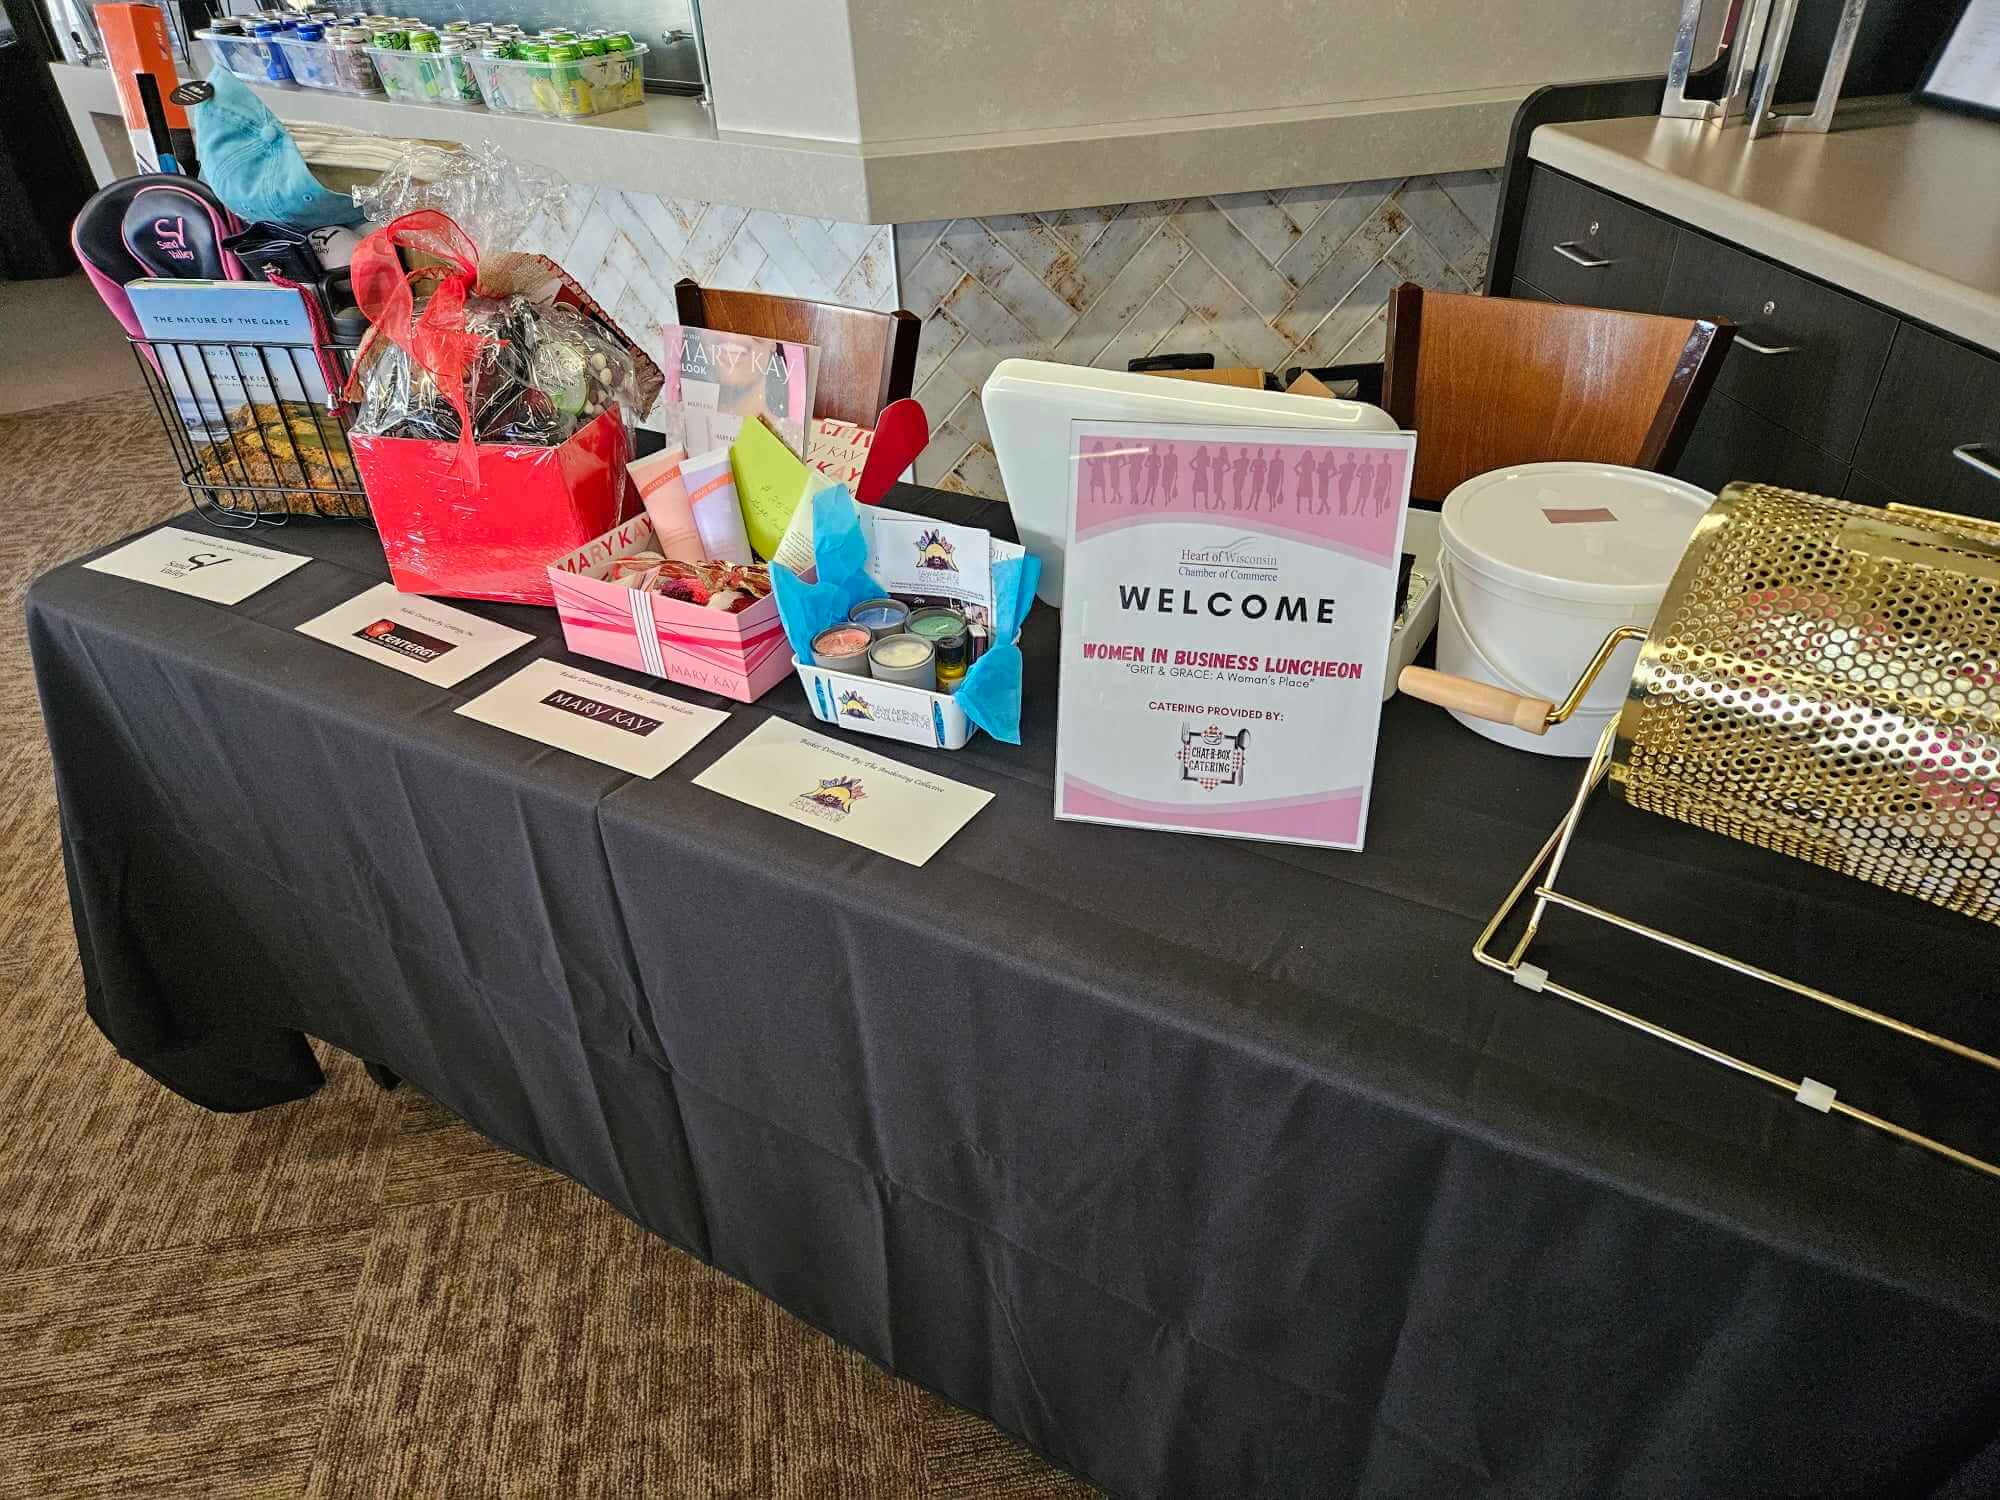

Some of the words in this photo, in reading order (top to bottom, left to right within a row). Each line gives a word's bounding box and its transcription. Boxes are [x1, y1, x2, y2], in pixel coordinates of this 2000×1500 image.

[156, 241, 180, 249] Sand
[168, 250, 195, 260] Valley
[153, 315, 173, 323] THE
[671, 337, 742, 373] MARY
[752, 352, 797, 385] KAY
[681, 363, 708, 376] LOOK
[1181, 549, 1209, 562] Heart
[1211, 550, 1224, 563] of
[1224, 552, 1278, 567] Wisconsin
[1178, 567, 1217, 579] Chamber
[1219, 569, 1229, 579] of
[1231, 571, 1278, 582] Commerce
[1119, 585, 1336, 624] WELCOME
[378, 633, 441, 658] CENTERGY
[1083, 644, 1145, 662] WOMEN
[1151, 648, 1169, 664] IN
[1175, 651, 1259, 672] BUSINESS
[1265, 658, 1363, 679] LUNCHEON
[670, 664, 709, 685] MARY
[713, 677, 740, 692] KAY
[1158, 666, 1167, 676] &
[1169, 667, 1214, 680] GRACE:
[1216, 670, 1224, 680] A
[549, 693, 609, 718] MARY
[1149, 701, 1204, 714] CATERING
[1207, 706, 1263, 719] PROVIDED
[1265, 711, 1284, 722] BY:
[1189, 760, 1230, 773] CATERING
